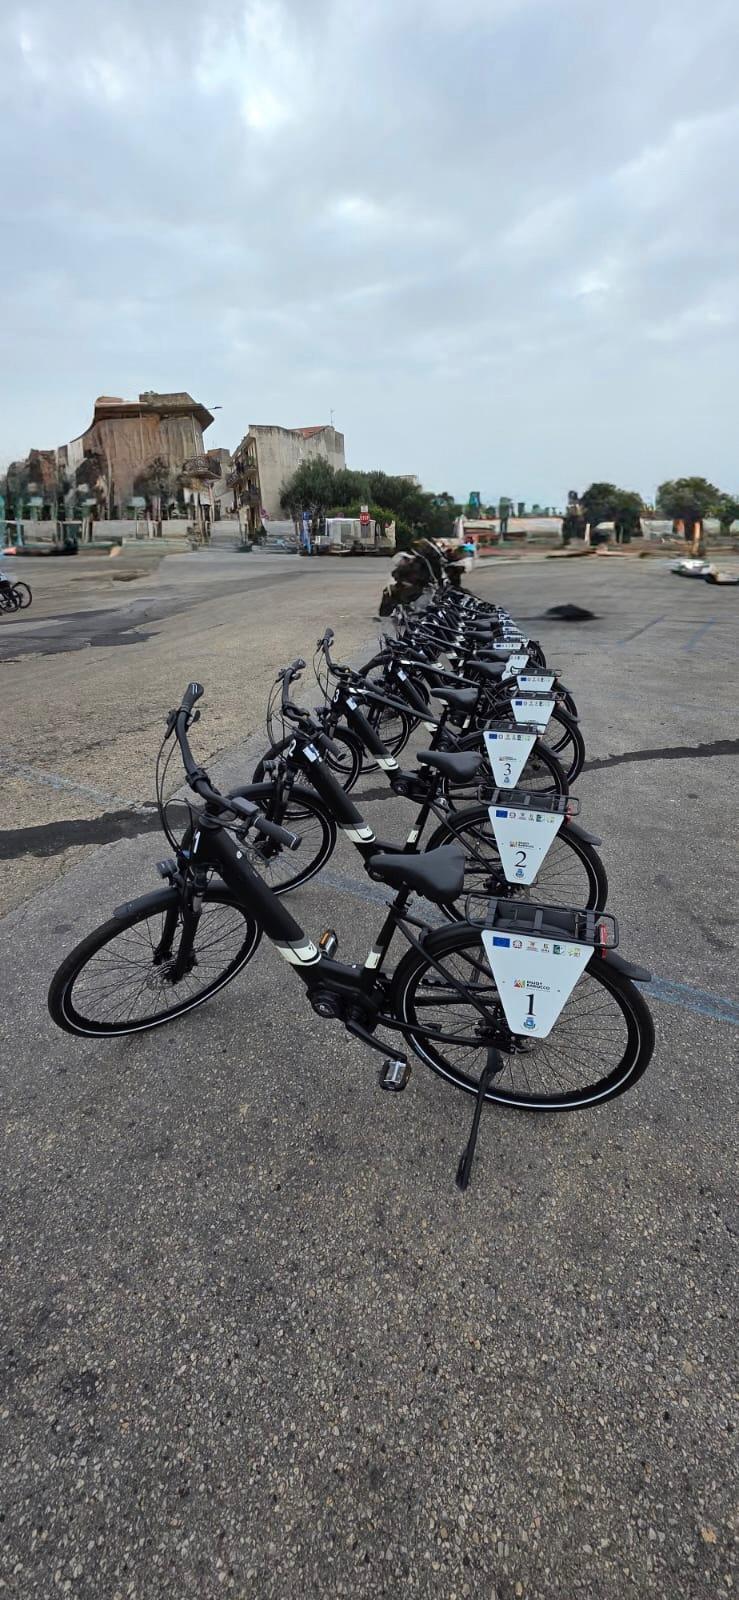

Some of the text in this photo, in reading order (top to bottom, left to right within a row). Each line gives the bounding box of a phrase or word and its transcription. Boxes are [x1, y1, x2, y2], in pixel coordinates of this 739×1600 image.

[333, 688, 340, 703] 3
[288, 738, 297, 757] 2
[503, 763, 512, 776] 3
[193, 831, 201, 854] 1
[514, 850, 527, 868] 2
[525, 993, 537, 1016] 1
